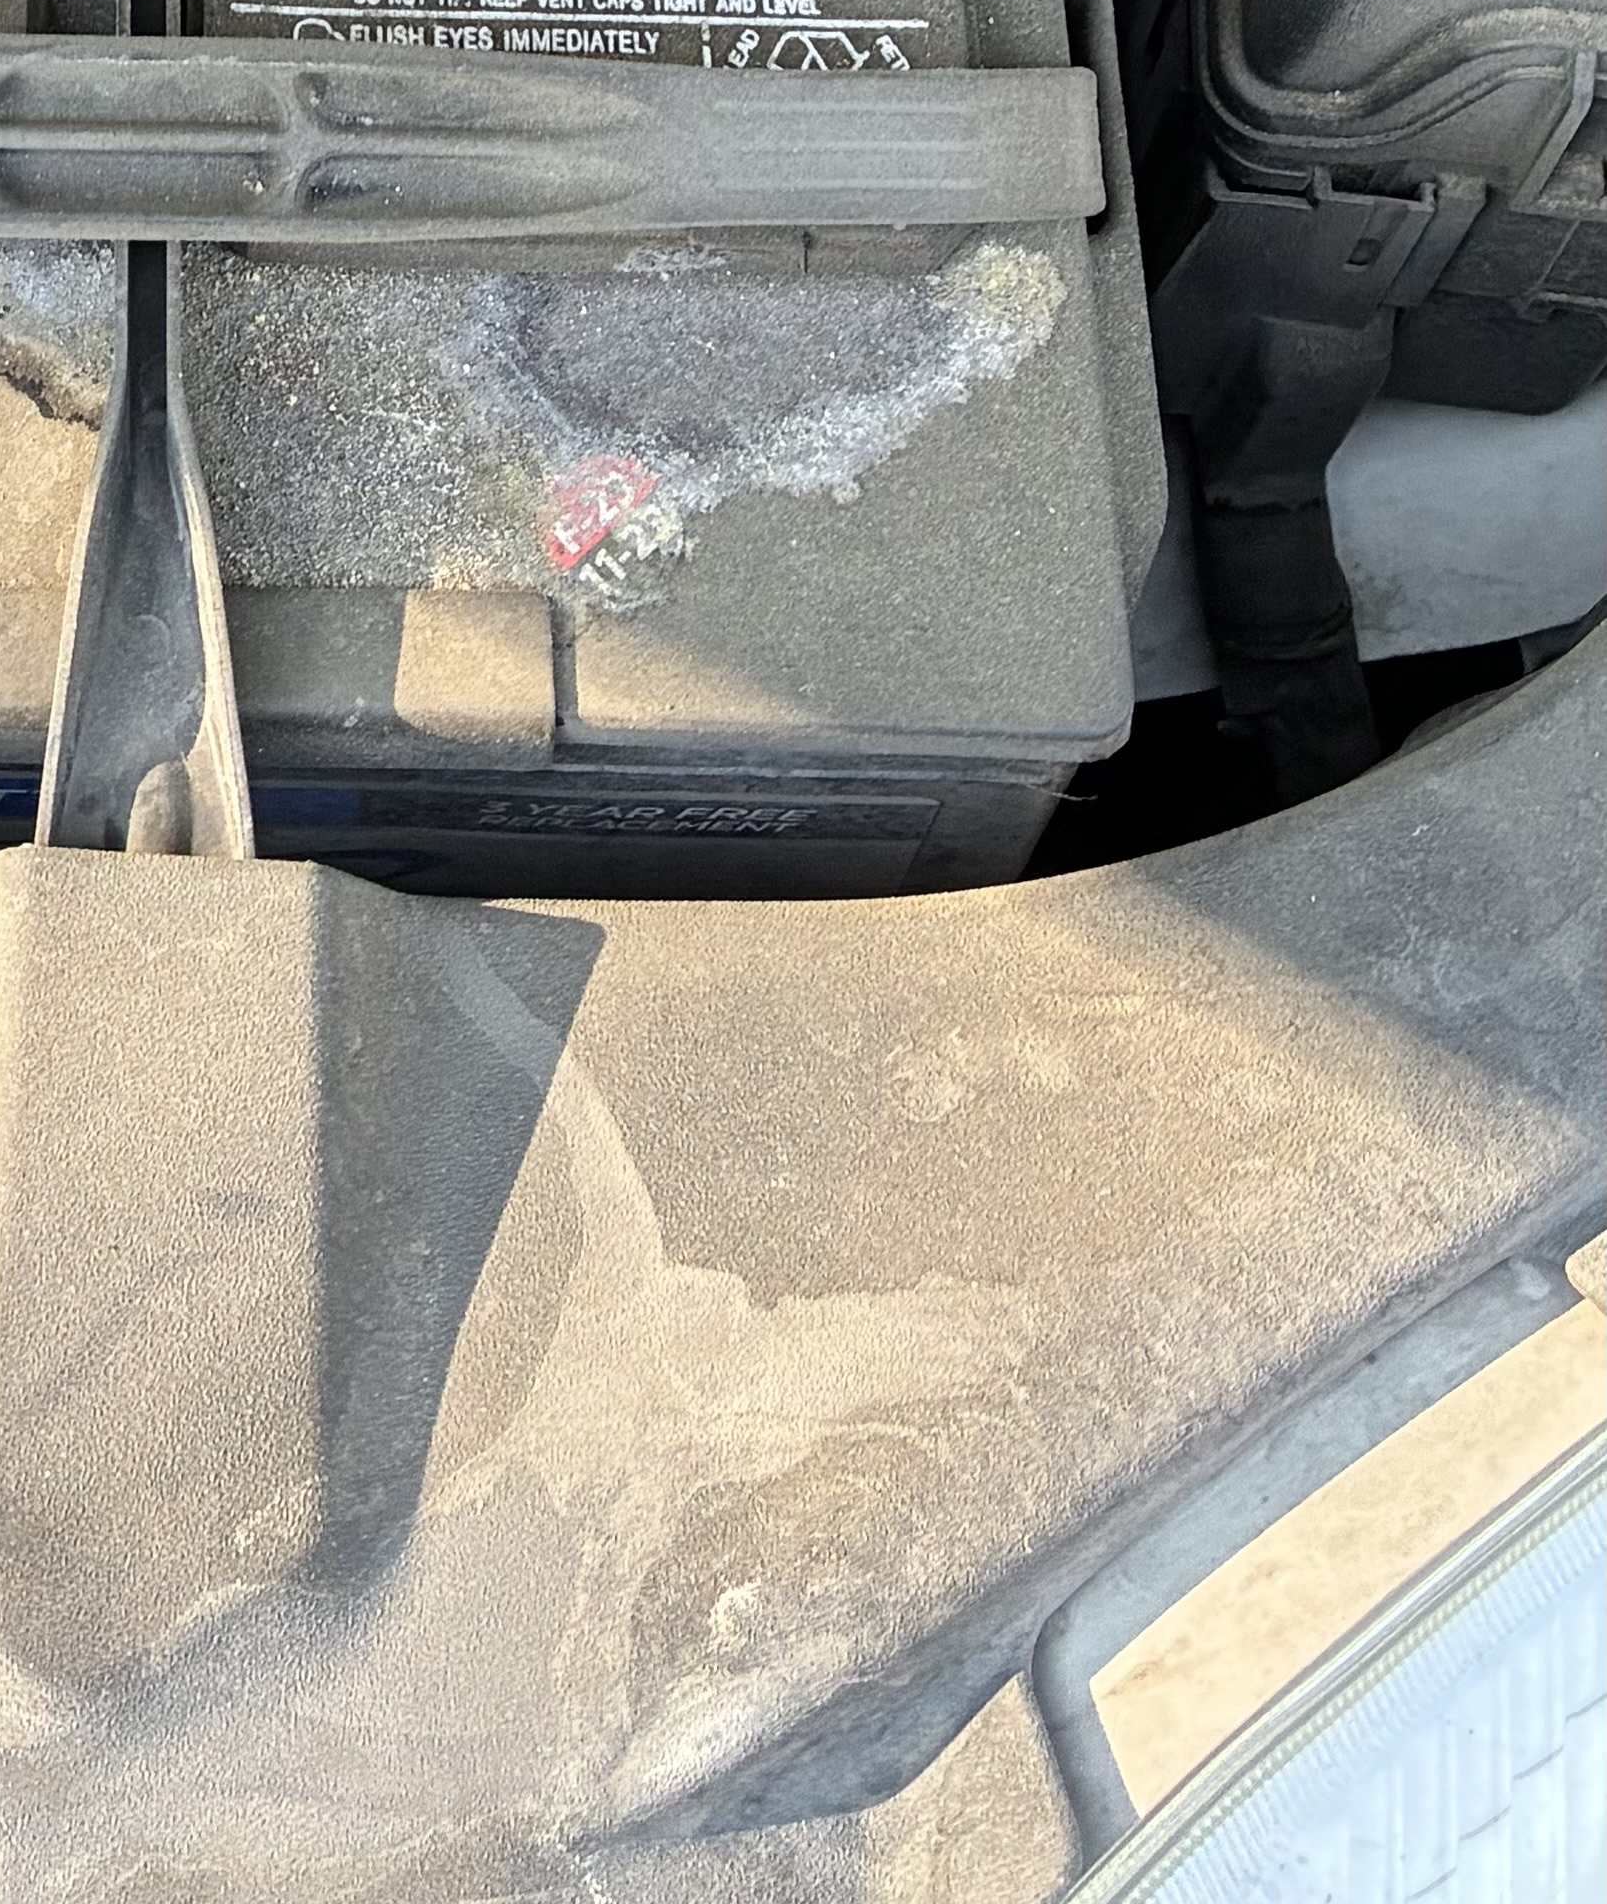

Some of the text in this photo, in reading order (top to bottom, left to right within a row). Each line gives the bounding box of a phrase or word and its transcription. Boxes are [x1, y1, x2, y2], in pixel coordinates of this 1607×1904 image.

[434, 26, 494, 51] EYES
[503, 28, 660, 55] IMMEDIATELY
[727, 28, 761, 69] EAD
[478, 814, 799, 833] REPLACEMENT
[528, 802, 667, 821] YEAR
[674, 805, 819, 823] FREE
